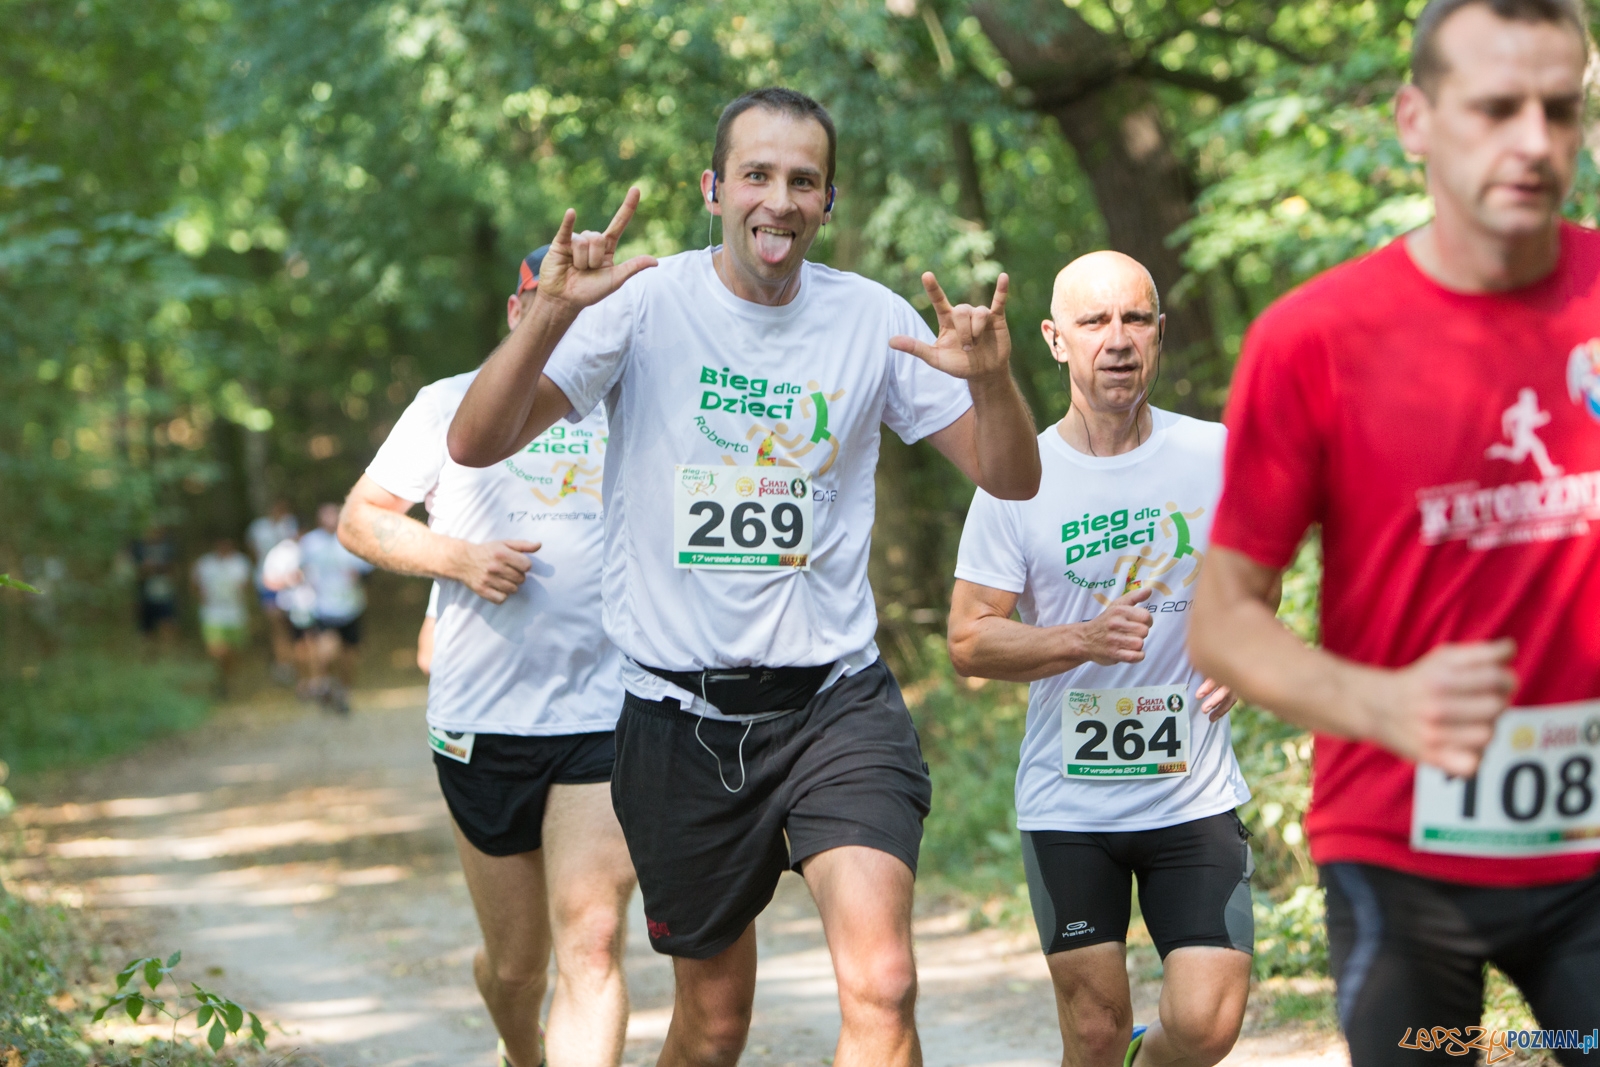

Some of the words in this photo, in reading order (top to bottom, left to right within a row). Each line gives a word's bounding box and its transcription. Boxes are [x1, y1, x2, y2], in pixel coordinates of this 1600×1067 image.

[699, 365, 768, 398] Bieg
[773, 382, 801, 395] dla
[699, 390, 794, 420] Dzieci
[520, 438, 589, 454] zieci
[570, 428, 593, 438] dla
[693, 415, 749, 454] Roberta
[507, 511, 528, 523] 17
[688, 500, 804, 549] 269
[1061, 509, 1128, 543] Bieg
[1134, 507, 1161, 521] dla
[1066, 521, 1155, 566] Dzieci
[1064, 570, 1116, 589] Roberta
[1075, 716, 1181, 761] 264
[1445, 756, 1594, 821] 108
